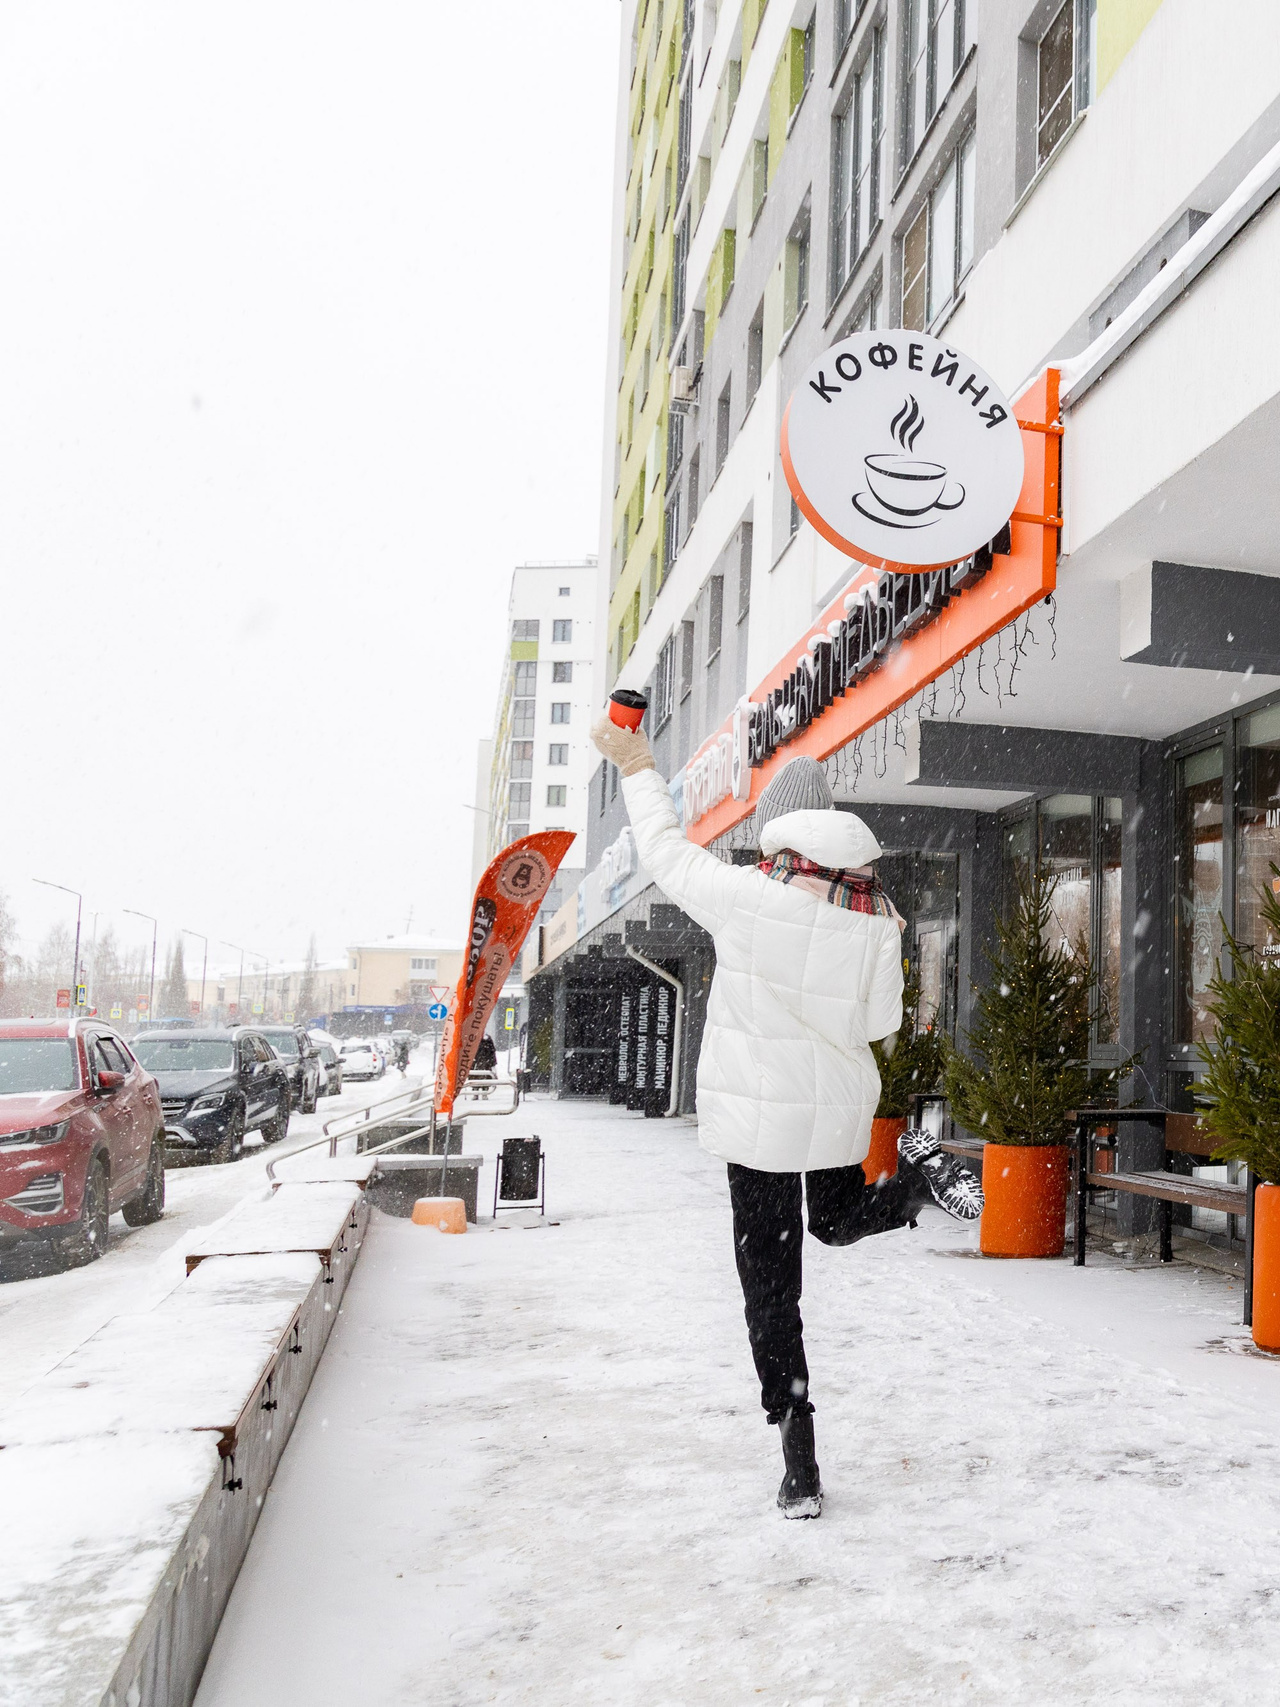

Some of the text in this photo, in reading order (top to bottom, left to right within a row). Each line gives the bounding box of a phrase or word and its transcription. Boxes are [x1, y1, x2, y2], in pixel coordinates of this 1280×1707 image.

[809, 342, 1008, 429] КОФЕЙНЯ
[748, 541, 993, 767] БОЛЬШАЯ МЕДВЕДИ
[454, 952, 504, 1098] аходите покушать!
[618, 995, 631, 1082] НЕВРОЛОГ, ОСТЕОПАТ
[636, 986, 649, 1089] КОНТУРНАЯ ПЛАСТИКА
[655, 986, 669, 1089] МАНИКЮР, ПЕДИКЮР
